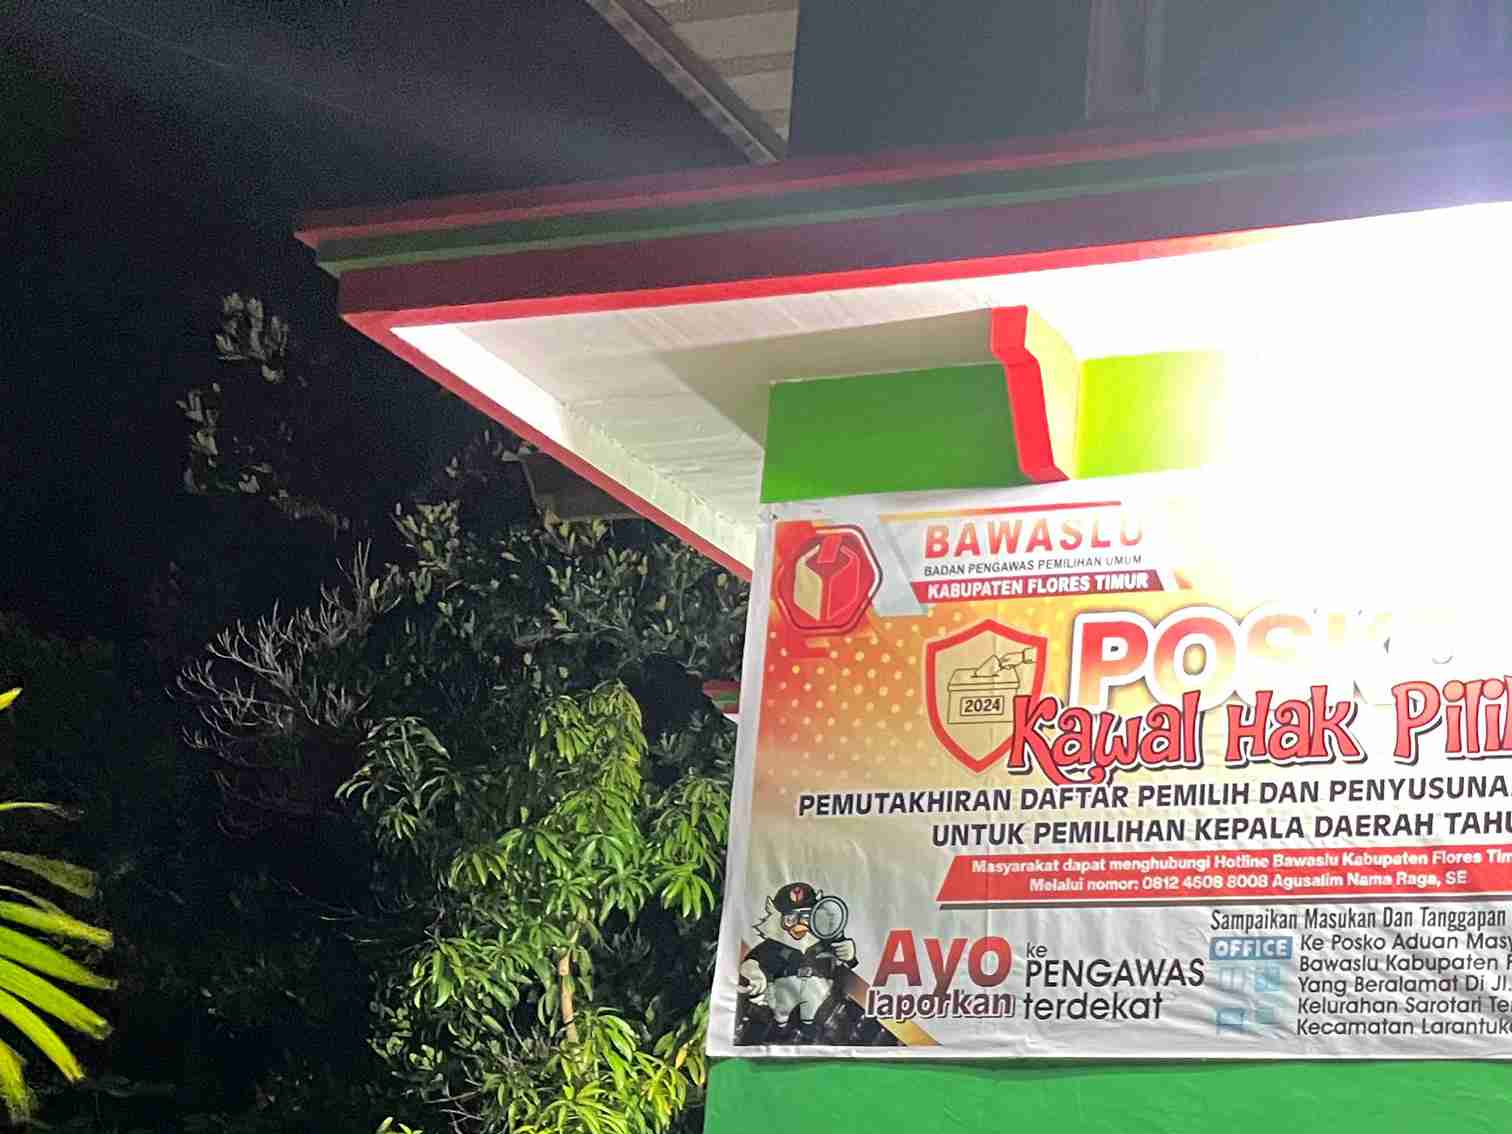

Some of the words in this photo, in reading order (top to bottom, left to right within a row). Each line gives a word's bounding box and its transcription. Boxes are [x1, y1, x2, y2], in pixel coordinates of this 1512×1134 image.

[924, 517, 1143, 559] BAWASLU
[924, 560, 965, 577] BADAN
[968, 559, 1034, 574] PENGAWAS
[1038, 556, 1101, 570] PEMILIHAN
[1106, 555, 1142, 566] UMUM
[928, 579, 1024, 600] KABUPATEN
[1027, 575, 1090, 594] FLORES
[1096, 572, 1149, 590] TIMUR
[964, 698, 1001, 713] 2024
[1008, 690, 1202, 783] Kawal
[1224, 685, 1363, 762] Hak
[799, 789, 1012, 816] PEMUTAKHIRAN
[1020, 784, 1129, 810] DAFTAR
[1138, 782, 1250, 807] PEMILIH
[1260, 780, 1319, 804] DAN
[932, 822, 1024, 847] UNTUK
[1033, 819, 1185, 844] PEMILIHAN
[1195, 816, 1304, 841] KEPALA
[1314, 813, 1433, 838] DAERAH
[972, 859, 1058, 875] Masyarakat
[1063, 858, 1105, 875] dapat
[1109, 855, 1209, 873] menghubungi
[1215, 854, 1268, 869] Hotline
[1273, 852, 1338, 867] Bawaslu
[1342, 850, 1428, 868] Kabupaten
[1432, 850, 1482, 865] Flores
[1030, 878, 1083, 891] Melalui
[1087, 878, 1138, 891] nomor:
[1142, 876, 1179, 889] 0812
[1272, 873, 1343, 889] Agusalim
[1347, 872, 1392, 887] Nama
[1445, 870, 1467, 885] SE
[1210, 908, 1298, 934] Sampaikan
[1304, 907, 1376, 929] Masukan
[1383, 906, 1414, 928] Dan
[1420, 907, 1506, 931] Tanggapan
[1026, 942, 1048, 958] ke
[1214, 939, 1288, 957] OFFICE
[1300, 935, 1324, 951] Ke
[1331, 934, 1386, 951] Posko
[1392, 933, 1458, 950] Aduan
[872, 929, 1013, 998] Ayo
[1025, 958, 1205, 988] PENGAWAS
[1300, 954, 1379, 972] Bawaslu
[1386, 954, 1498, 974] Kabupaten
[1298, 977, 1347, 997] Yang
[1354, 975, 1458, 993] Beralamat
[1465, 975, 1484, 992] Di
[867, 988, 1016, 1022] laporkan
[1023, 991, 1163, 1020] terdekat
[1298, 997, 1397, 1014] Kelurahan
[1404, 997, 1481, 1014] Sarotari
[1297, 1019, 1414, 1036] Kecamatan
